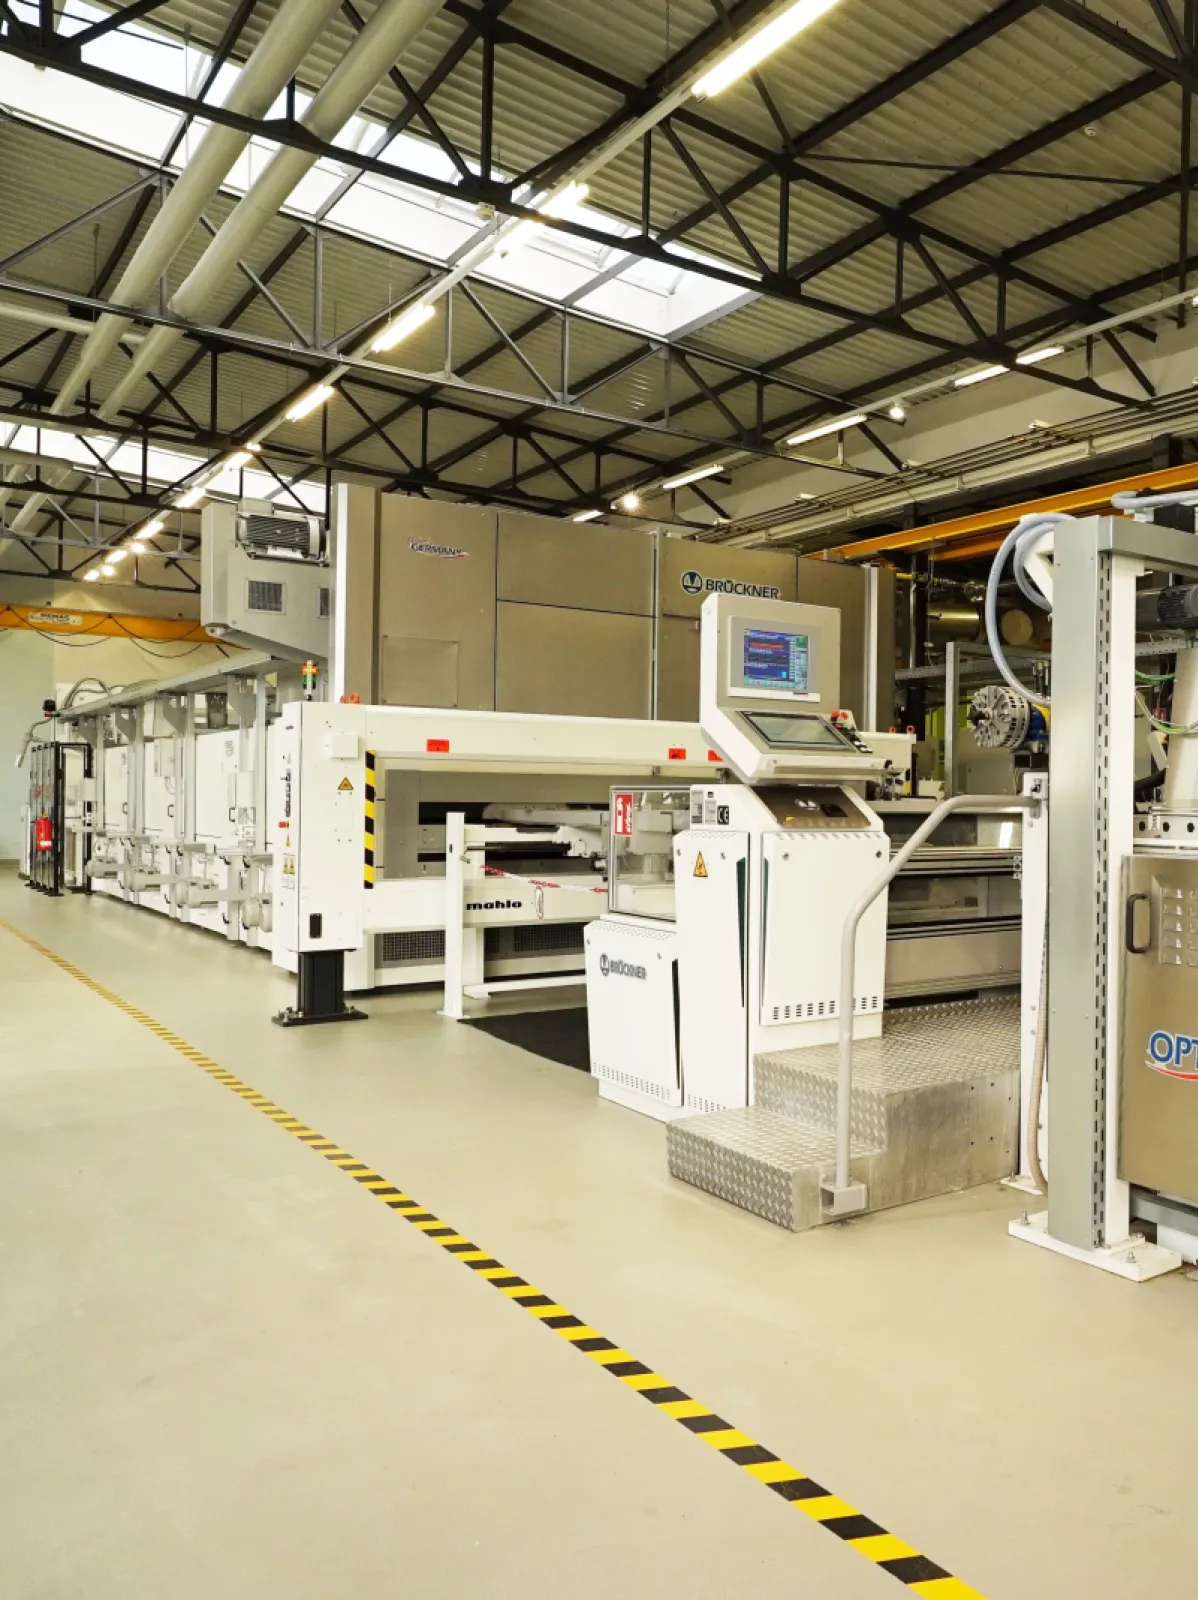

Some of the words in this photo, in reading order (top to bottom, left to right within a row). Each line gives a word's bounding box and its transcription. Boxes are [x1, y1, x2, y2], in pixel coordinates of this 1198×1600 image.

[705, 579, 779, 599] BRÜCKNER
[466, 900, 522, 910] mahlo
[610, 959, 647, 980] BRÜCKNER
